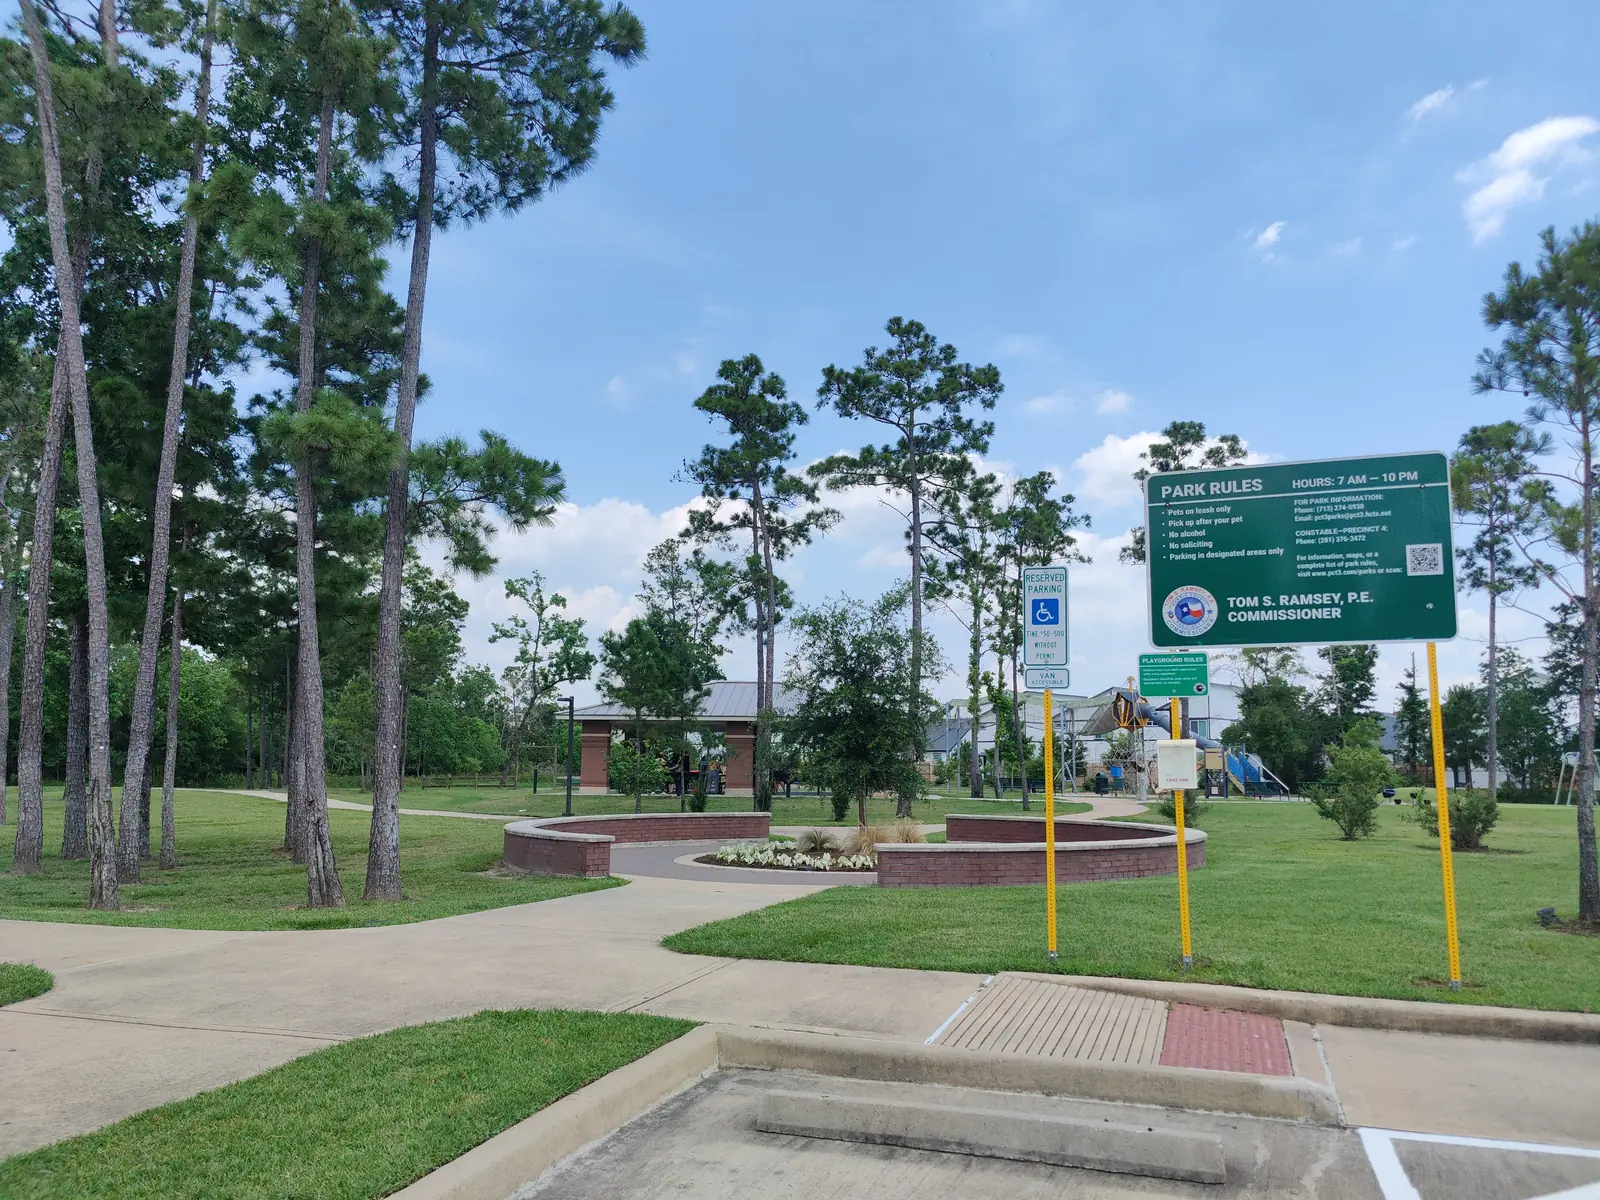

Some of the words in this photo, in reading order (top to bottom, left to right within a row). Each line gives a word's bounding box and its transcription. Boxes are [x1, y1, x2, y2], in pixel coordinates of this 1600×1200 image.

[1292, 477, 1335, 489] HOURS:
[1337, 476, 1344, 485] 7
[1347, 475, 1366, 485] AM
[1382, 473, 1396, 482] 10
[1399, 471, 1418, 481] PM
[1162, 484, 1206, 498] PARK
[1210, 479, 1262, 494] RULES
[1330, 494, 1384, 503] INFORMATION:
[1216, 505, 1231, 514] only
[1195, 518, 1212, 526] after
[1213, 517, 1230, 526] your
[1231, 516, 1243, 524] pet
[1180, 529, 1205, 537] alcohol
[1180, 541, 1213, 549] soliciting
[1206, 549, 1245, 559] designated
[1268, 547, 1284, 556] only
[1026, 574, 1065, 583] RESERVED
[1028, 585, 1062, 593] PARKING
[1227, 596, 1259, 608] TOM
[1262, 596, 1276, 606] S.
[1279, 593, 1344, 606] RAMSEY,
[1348, 591, 1374, 604] P.E.
[1228, 608, 1342, 622] COMMISSIONER
[1166, 618, 1214, 636] COMMISSIONER
